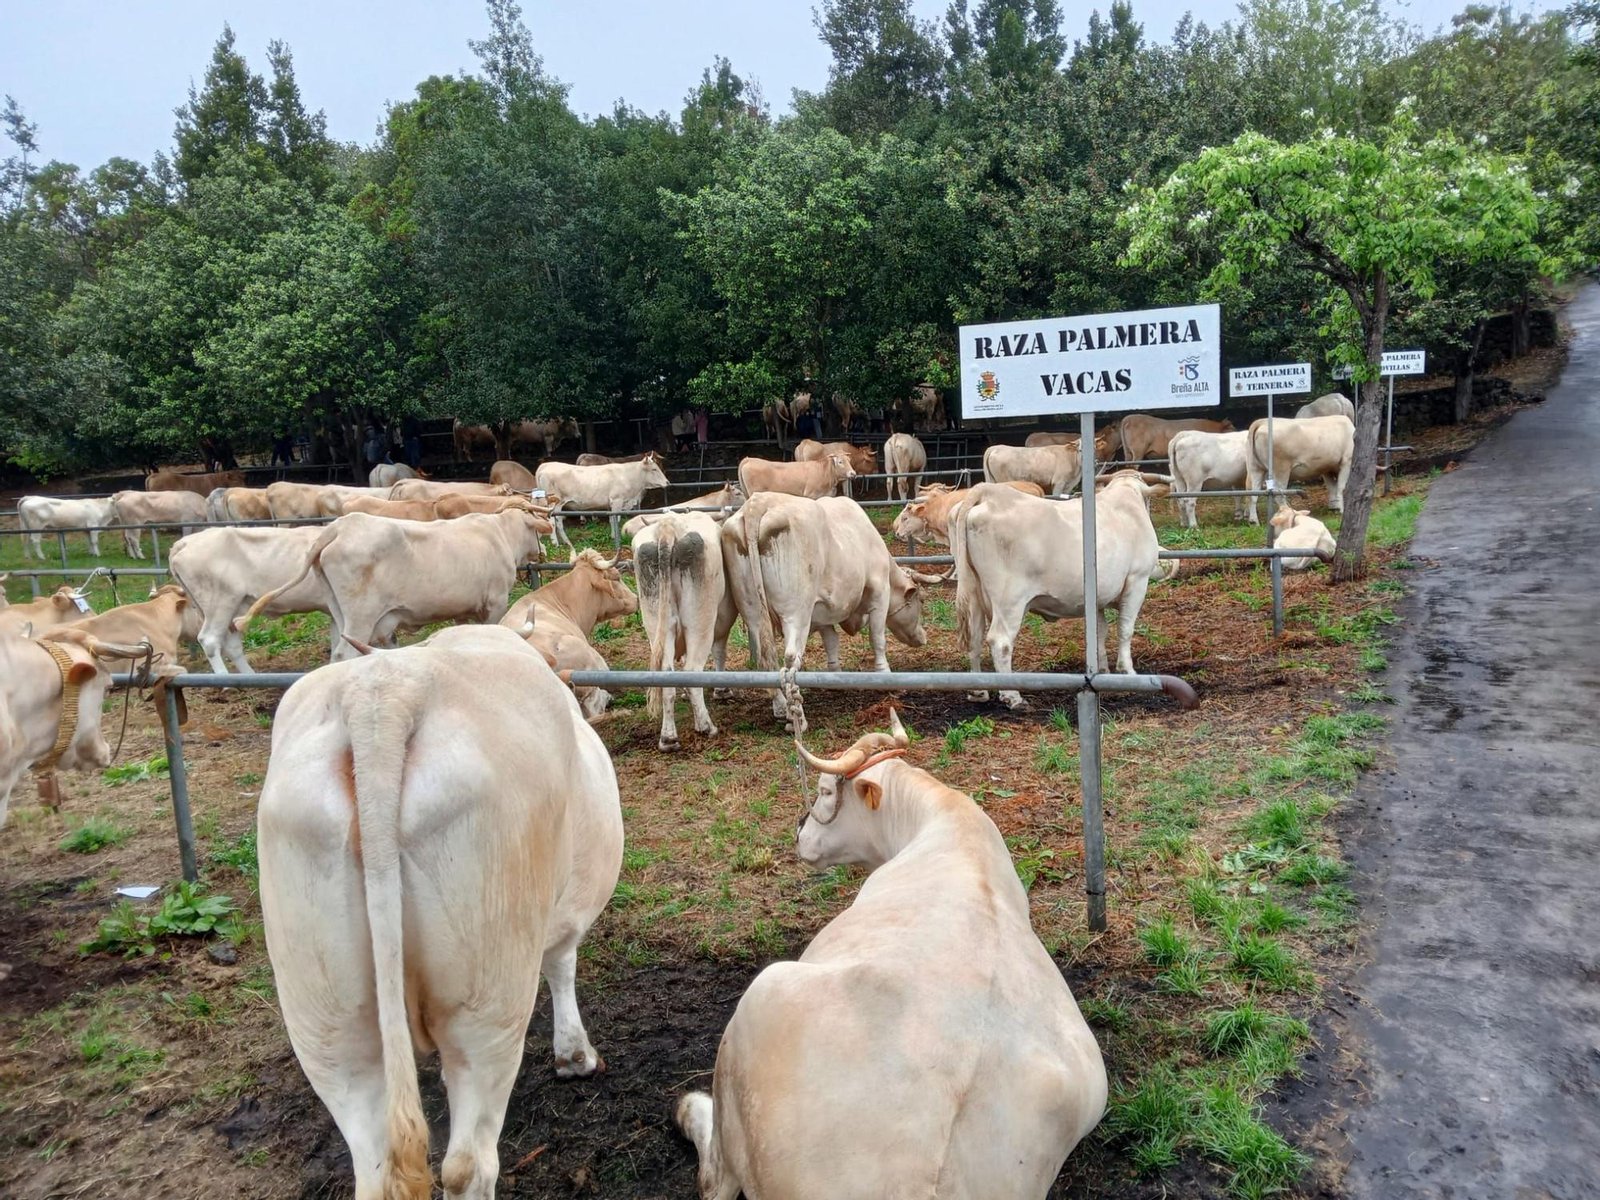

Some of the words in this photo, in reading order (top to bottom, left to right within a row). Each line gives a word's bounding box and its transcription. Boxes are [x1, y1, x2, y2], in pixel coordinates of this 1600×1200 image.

[974, 332, 1048, 360] RAZA
[1058, 319, 1202, 352] PALMERA
[1386, 353, 1421, 361] PALMERA
[1234, 370, 1259, 379] RAZA
[1261, 367, 1306, 378] PALMERA
[1040, 368, 1132, 396] VACAS
[1171, 383, 1192, 393] Breña
[1194, 382, 1209, 392] ALTA
[1246, 381, 1294, 391] TERNERAS
